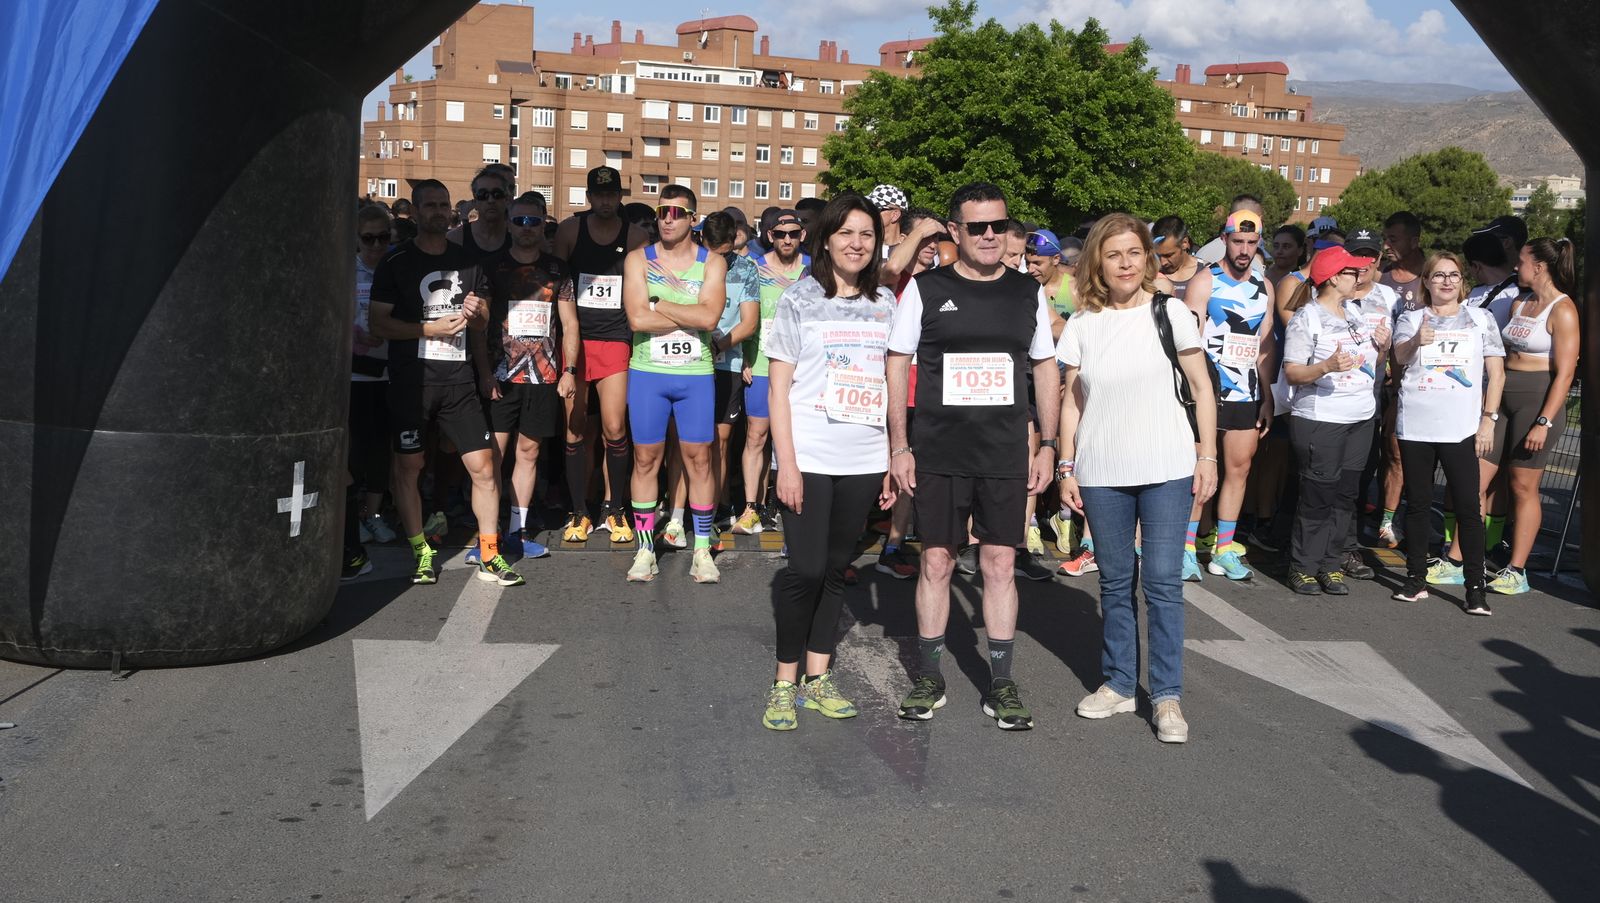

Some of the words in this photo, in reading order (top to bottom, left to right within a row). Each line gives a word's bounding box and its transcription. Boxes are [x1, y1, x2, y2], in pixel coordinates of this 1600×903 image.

[587, 285, 612, 298] 131
[519, 312, 548, 325] 1240
[1508, 325, 1531, 338] 1089
[661, 342, 692, 355] 159
[1228, 344, 1257, 358] 1055
[1438, 341, 1459, 353] 17
[952, 371, 1007, 388] 1035
[835, 387, 883, 408] 1064
